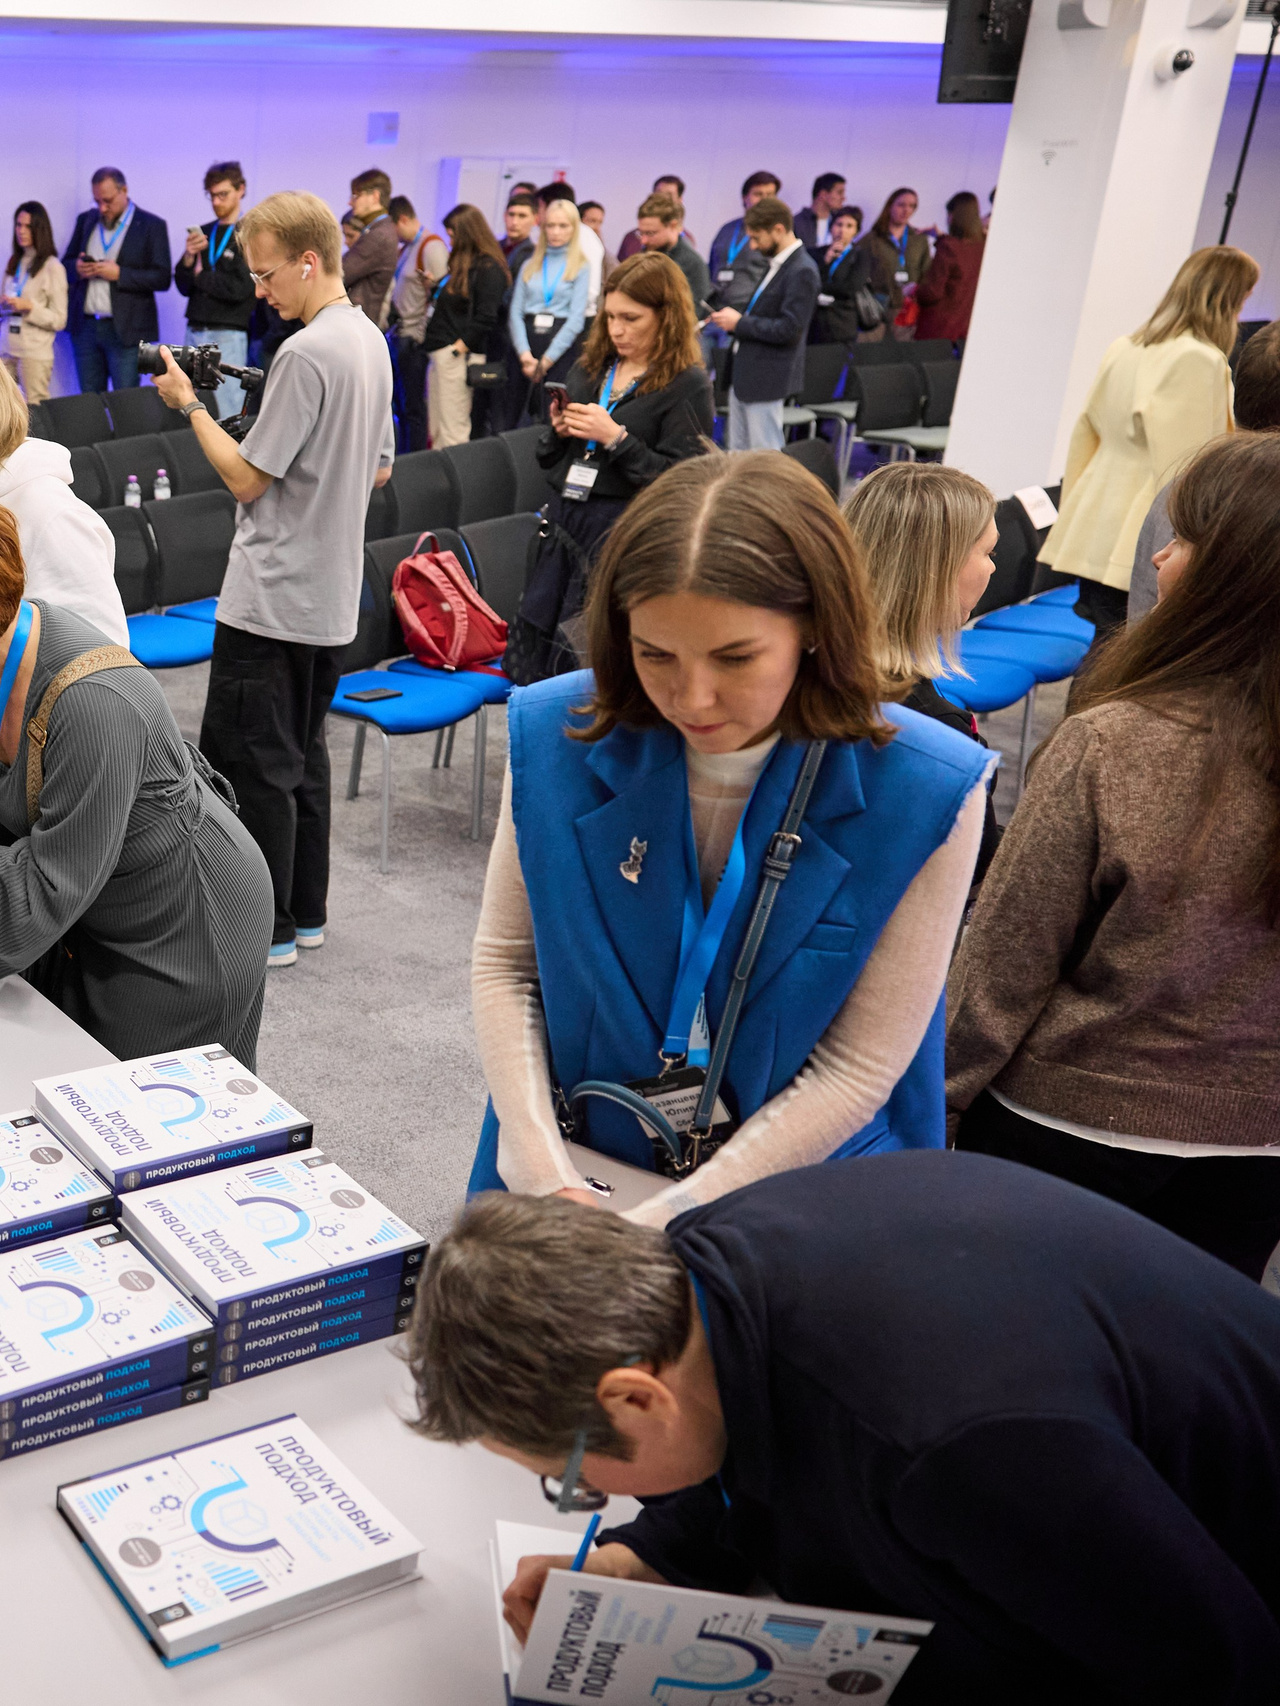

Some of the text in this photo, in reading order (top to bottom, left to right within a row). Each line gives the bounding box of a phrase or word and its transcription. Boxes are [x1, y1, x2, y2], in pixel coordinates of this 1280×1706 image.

[54, 1084, 133, 1156] ПРОДУКТОВЫЙ
[105, 1110, 152, 1151] ПОДХОД
[665, 1105, 696, 1117] Юлия
[146, 1144, 257, 1180] ПРОДУКТОВЫЙ ПОДХОД
[11, 1220, 53, 1238] ПОДХОД
[142, 1198, 236, 1283] ПРОДУКТОВЫЙ
[201, 1228, 257, 1277] ПОДХОД
[248, 1289, 366, 1330] ПРОДУКТОВЫЙ ПОДХОД
[252, 1268, 369, 1309] ПРОДУКТОВЫЙ ПОДХОД
[243, 1332, 360, 1373] ПРОДУКТОВЫЙ ПОДХОД
[245, 1311, 362, 1352] ПРОДУКТОВЫЙ ПОДХОД
[21, 1358, 150, 1409] ПРОДУКТОВЫЙ ПОДХОД
[22, 1378, 150, 1429] ПРОДУКТОВЫЙ ПОДХОД
[11, 1404, 143, 1451] ПРОДУКТОВЫЙ ПОДХОД
[255, 1443, 318, 1506] ПОДХОД
[278, 1435, 395, 1546] ПРОДУКТОВЫЙ
[546, 1589, 602, 1693] ПРОДУКТОВЫЙ
[579, 1640, 626, 1698] ПОДХОД
